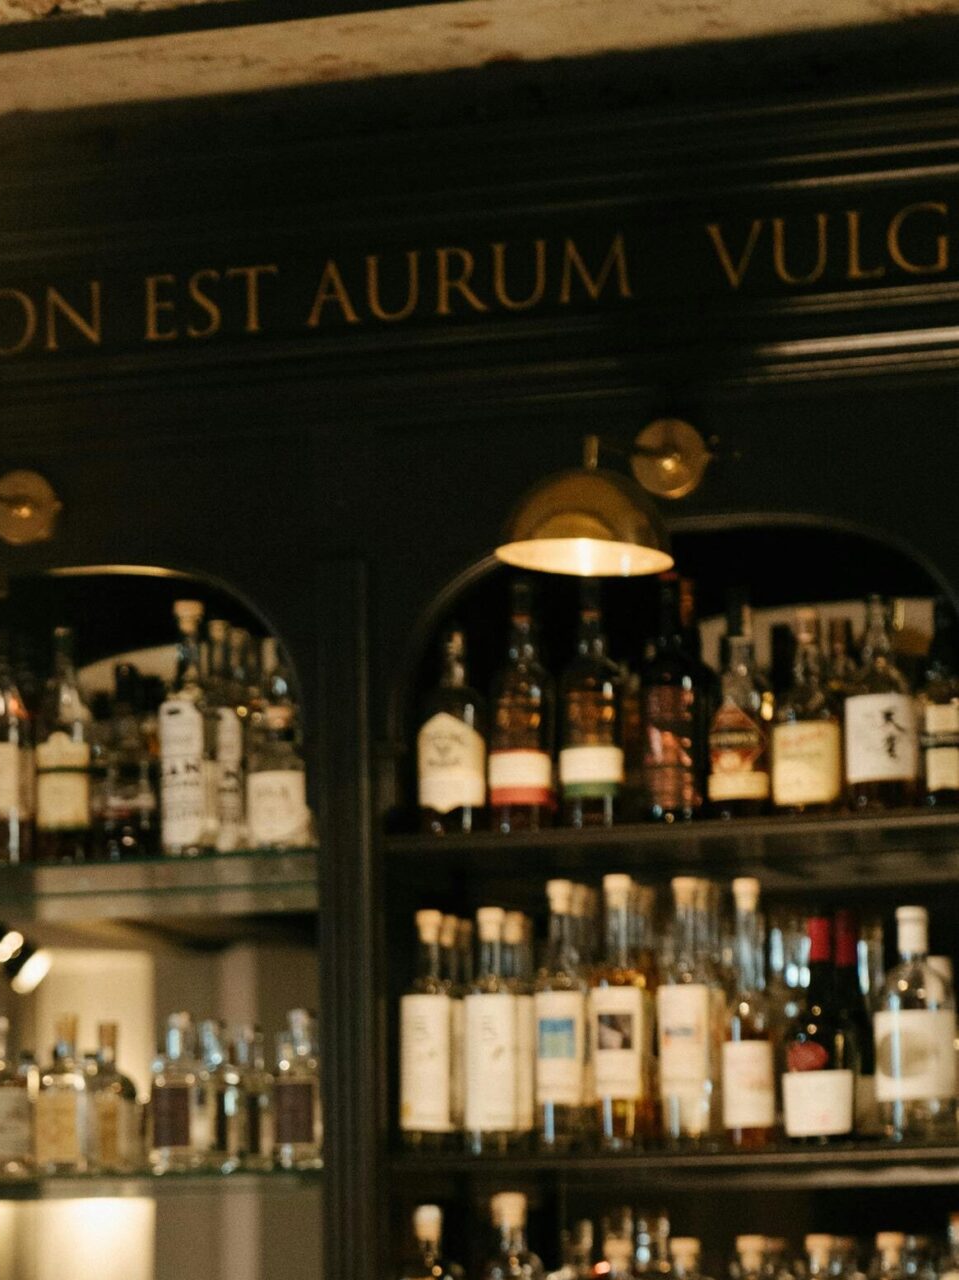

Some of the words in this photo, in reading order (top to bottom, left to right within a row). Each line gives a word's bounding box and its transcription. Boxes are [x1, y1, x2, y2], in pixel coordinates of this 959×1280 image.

[143, 262, 280, 342] EST
[305, 234, 634, 329] AURUM
[706, 201, 951, 290] VULG
